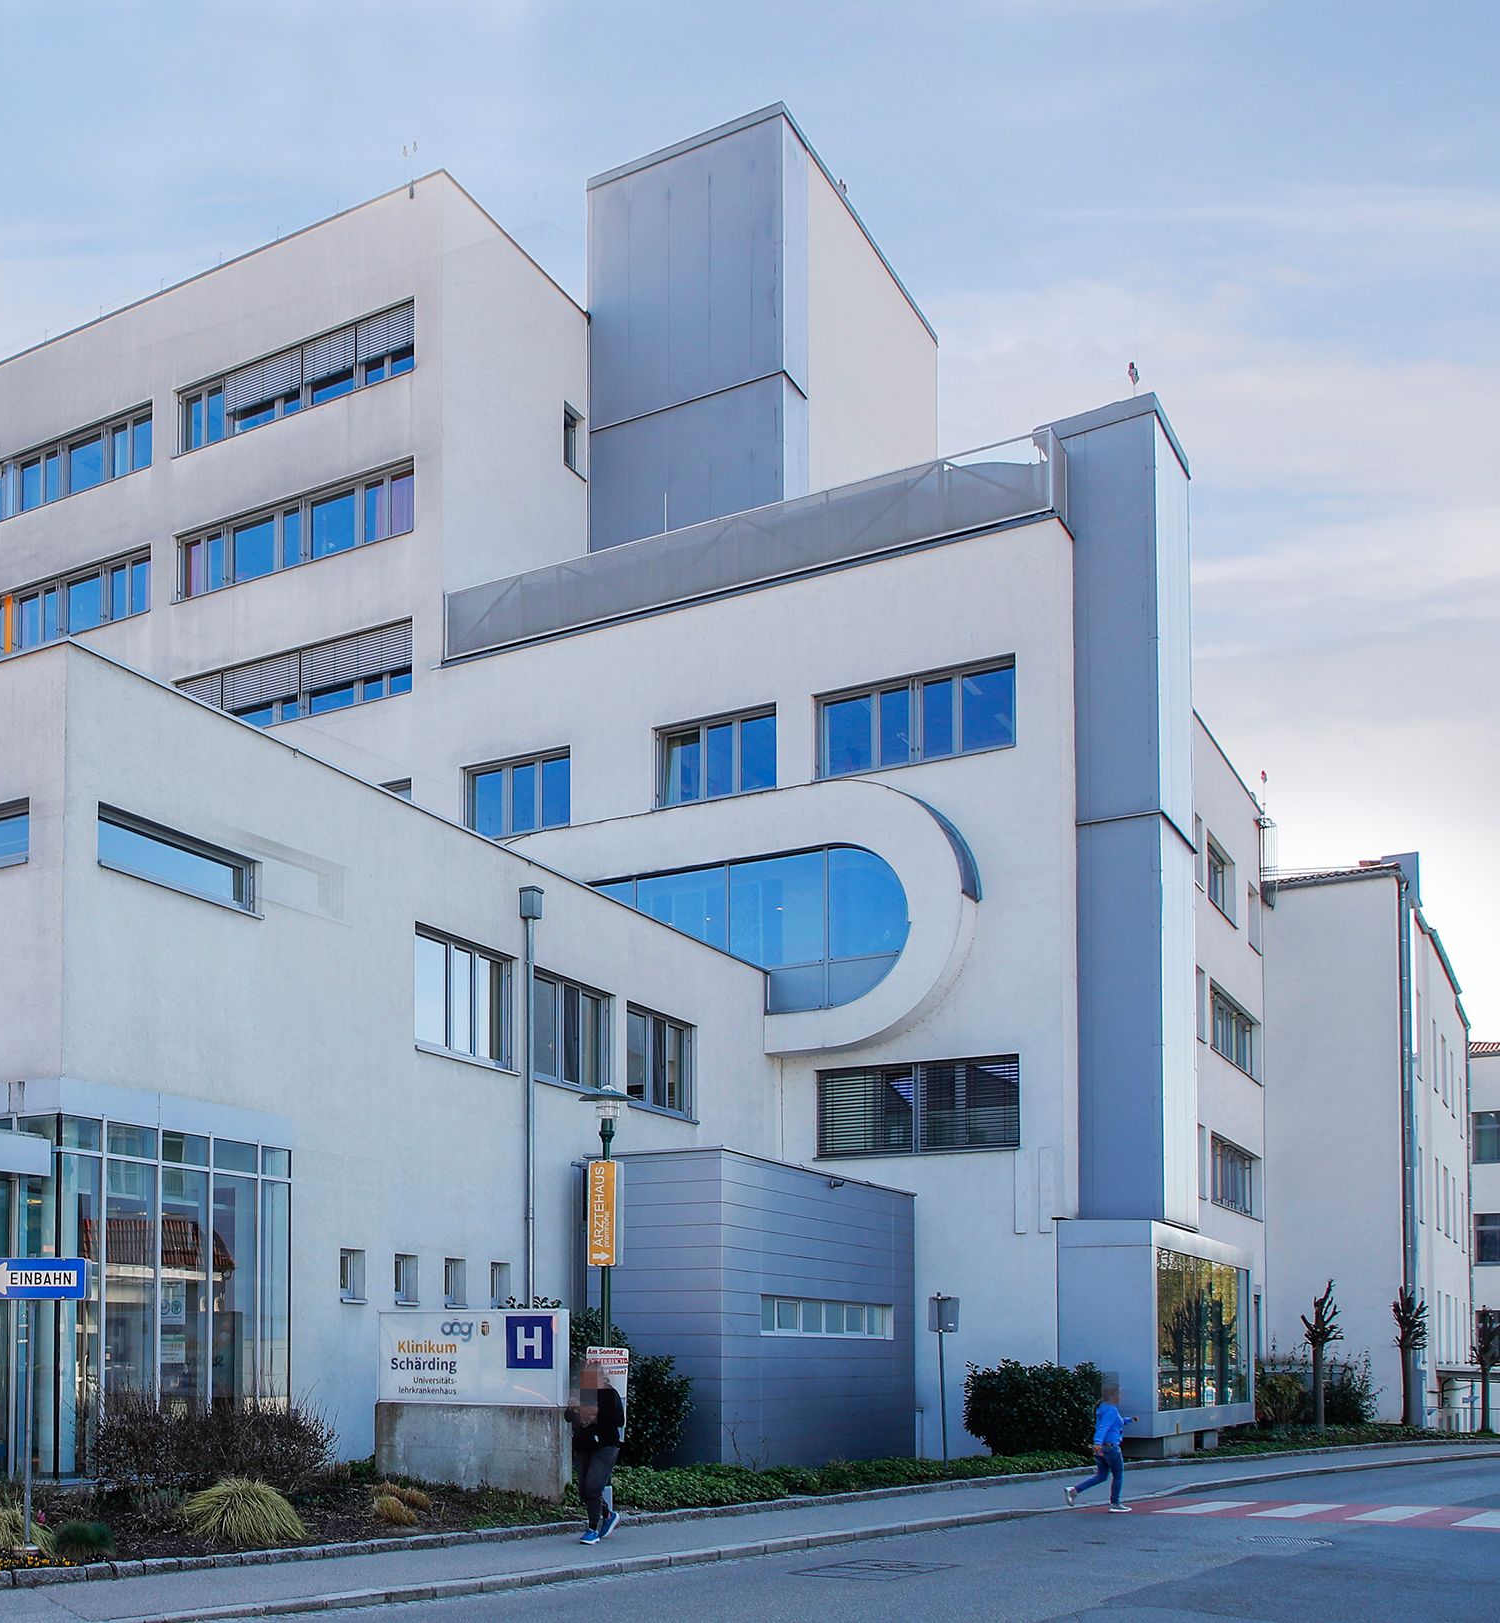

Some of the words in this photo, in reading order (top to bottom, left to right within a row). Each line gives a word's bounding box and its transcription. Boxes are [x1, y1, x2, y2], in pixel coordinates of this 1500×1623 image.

[592, 1166, 605, 1247] ÄRZTEHAUS
[10, 1272, 72, 1286] EINBAHN
[398, 1340, 457, 1353] Klinikum
[516, 1326, 542, 1360] H
[391, 1357, 457, 1374] Schärding
[413, 1376, 457, 1385] Universitäts-
[398, 1386, 457, 1395] lehrkrankenhaus
